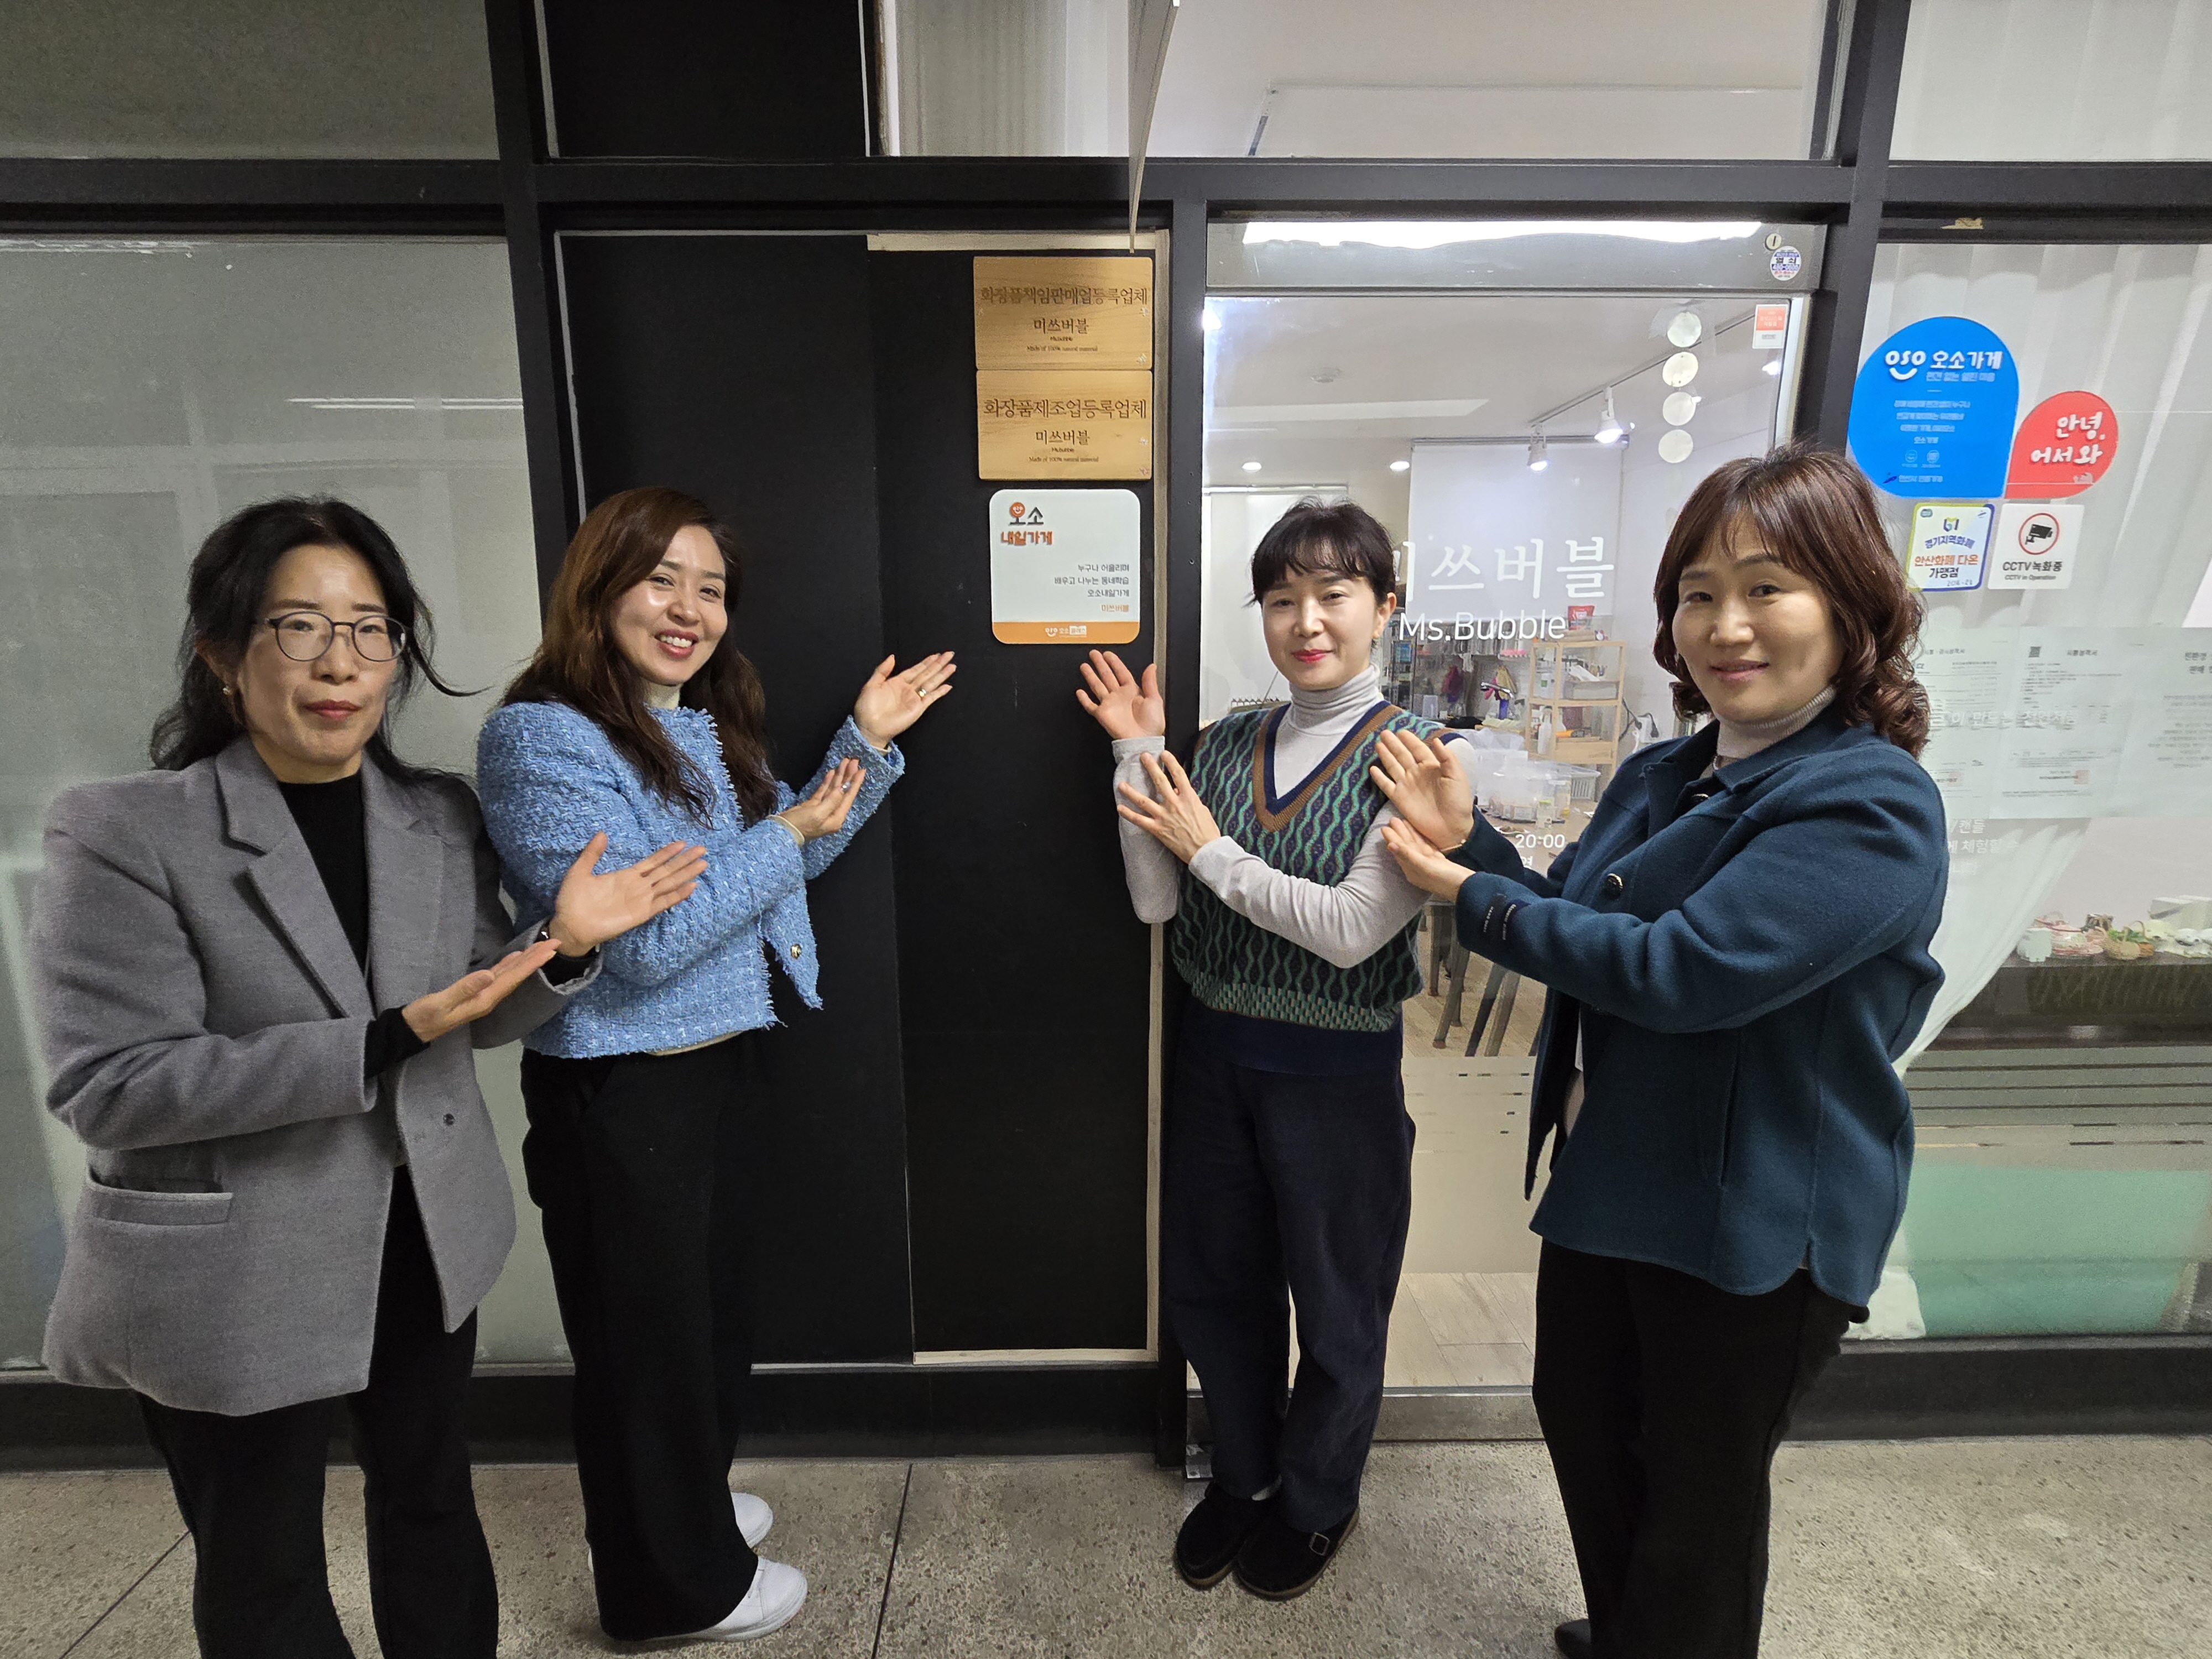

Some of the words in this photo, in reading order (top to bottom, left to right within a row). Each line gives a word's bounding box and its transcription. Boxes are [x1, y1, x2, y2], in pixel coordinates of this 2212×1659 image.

[980, 286, 1147, 305] 화장품책임판매업등록업체
[1034, 318, 1089, 334] 미쓰버블
[1930, 350, 2003, 369] 오소가게
[984, 399, 1146, 419] 화장품제조업등록업체
[1036, 430, 1090, 445] 미쓰버블
[1001, 530, 1053, 546] 내일가게
[1914, 555, 1954, 566] 안산화폐
[1958, 555, 1979, 565] 다온
[1929, 567, 1959, 578] 가맹점
[1087, 589, 1129, 597] 오소내일가게
[1399, 609, 1567, 641] Ms.Bubble
[1515, 834, 1565, 848] 20:00
